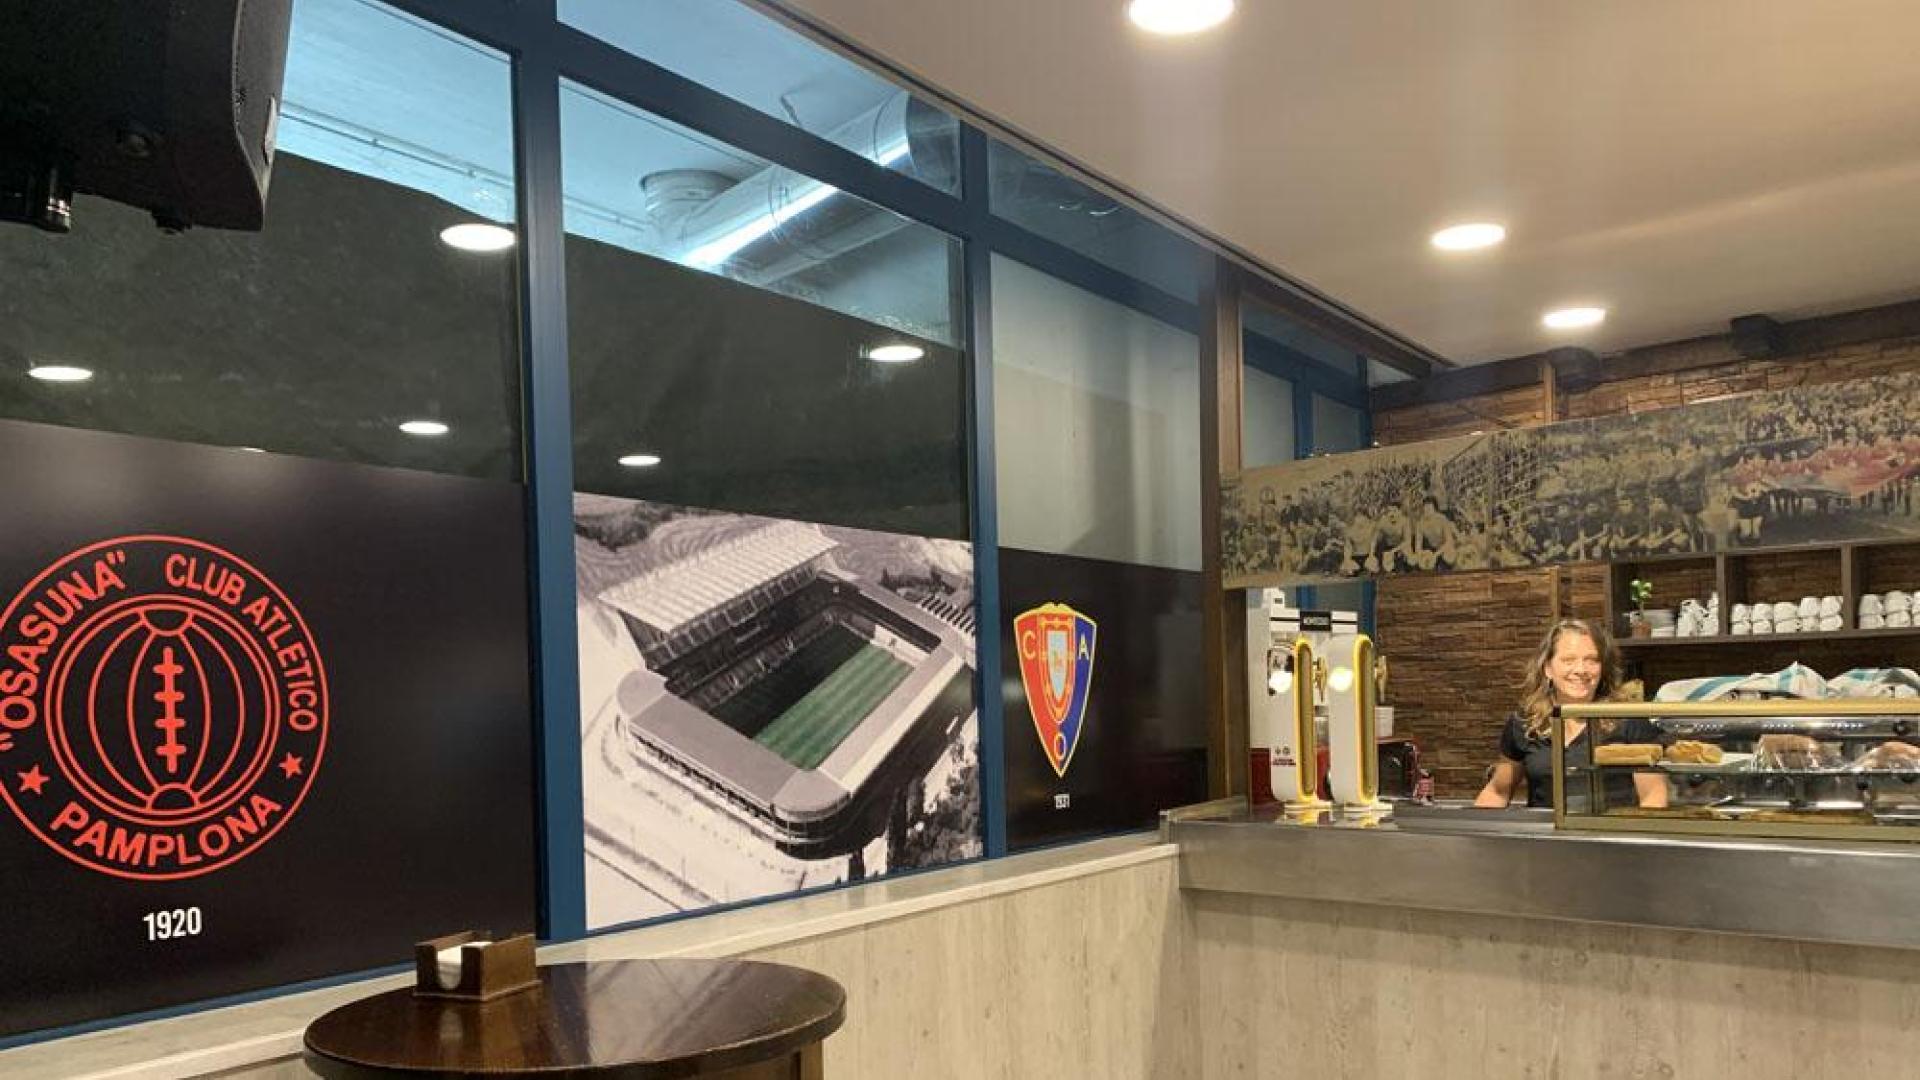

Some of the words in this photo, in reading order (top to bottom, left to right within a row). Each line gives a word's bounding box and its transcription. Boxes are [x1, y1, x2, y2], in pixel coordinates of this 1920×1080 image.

[165, 553, 246, 605] CLUB
[242, 596, 318, 731] ATLETICO
[50, 795, 281, 866] PAMPLONA
[143, 907, 201, 941] 1920
